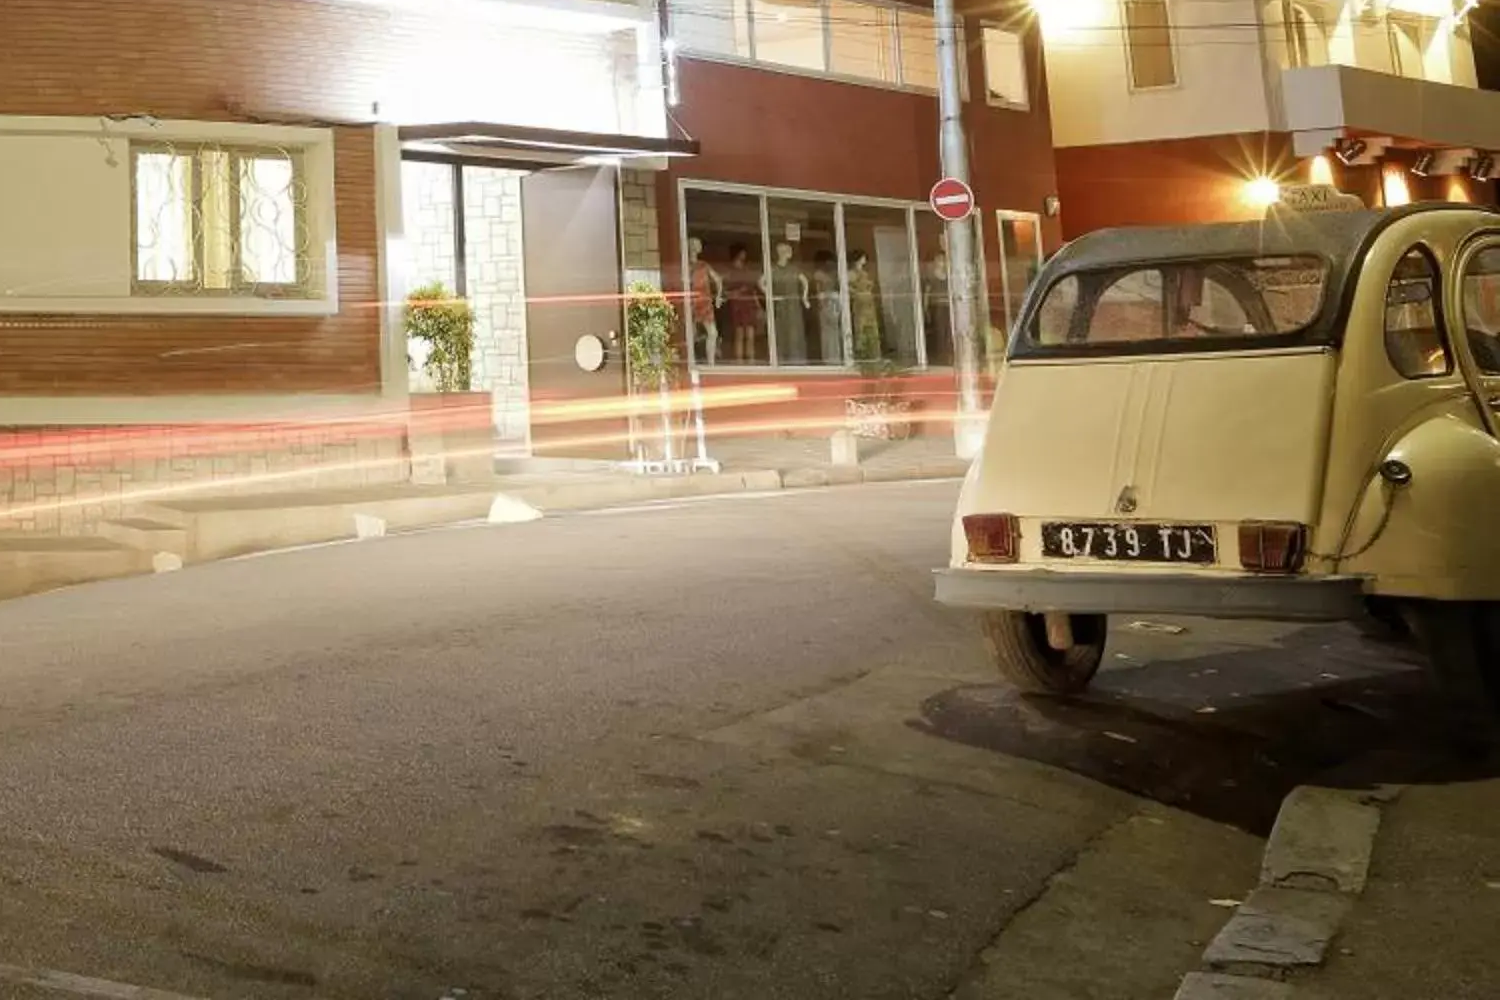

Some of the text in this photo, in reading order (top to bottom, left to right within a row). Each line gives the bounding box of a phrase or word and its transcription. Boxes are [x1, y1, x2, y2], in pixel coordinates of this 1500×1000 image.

[1290, 186, 1329, 204] TAXI
[1061, 527, 1192, 559] 8739 TJ
